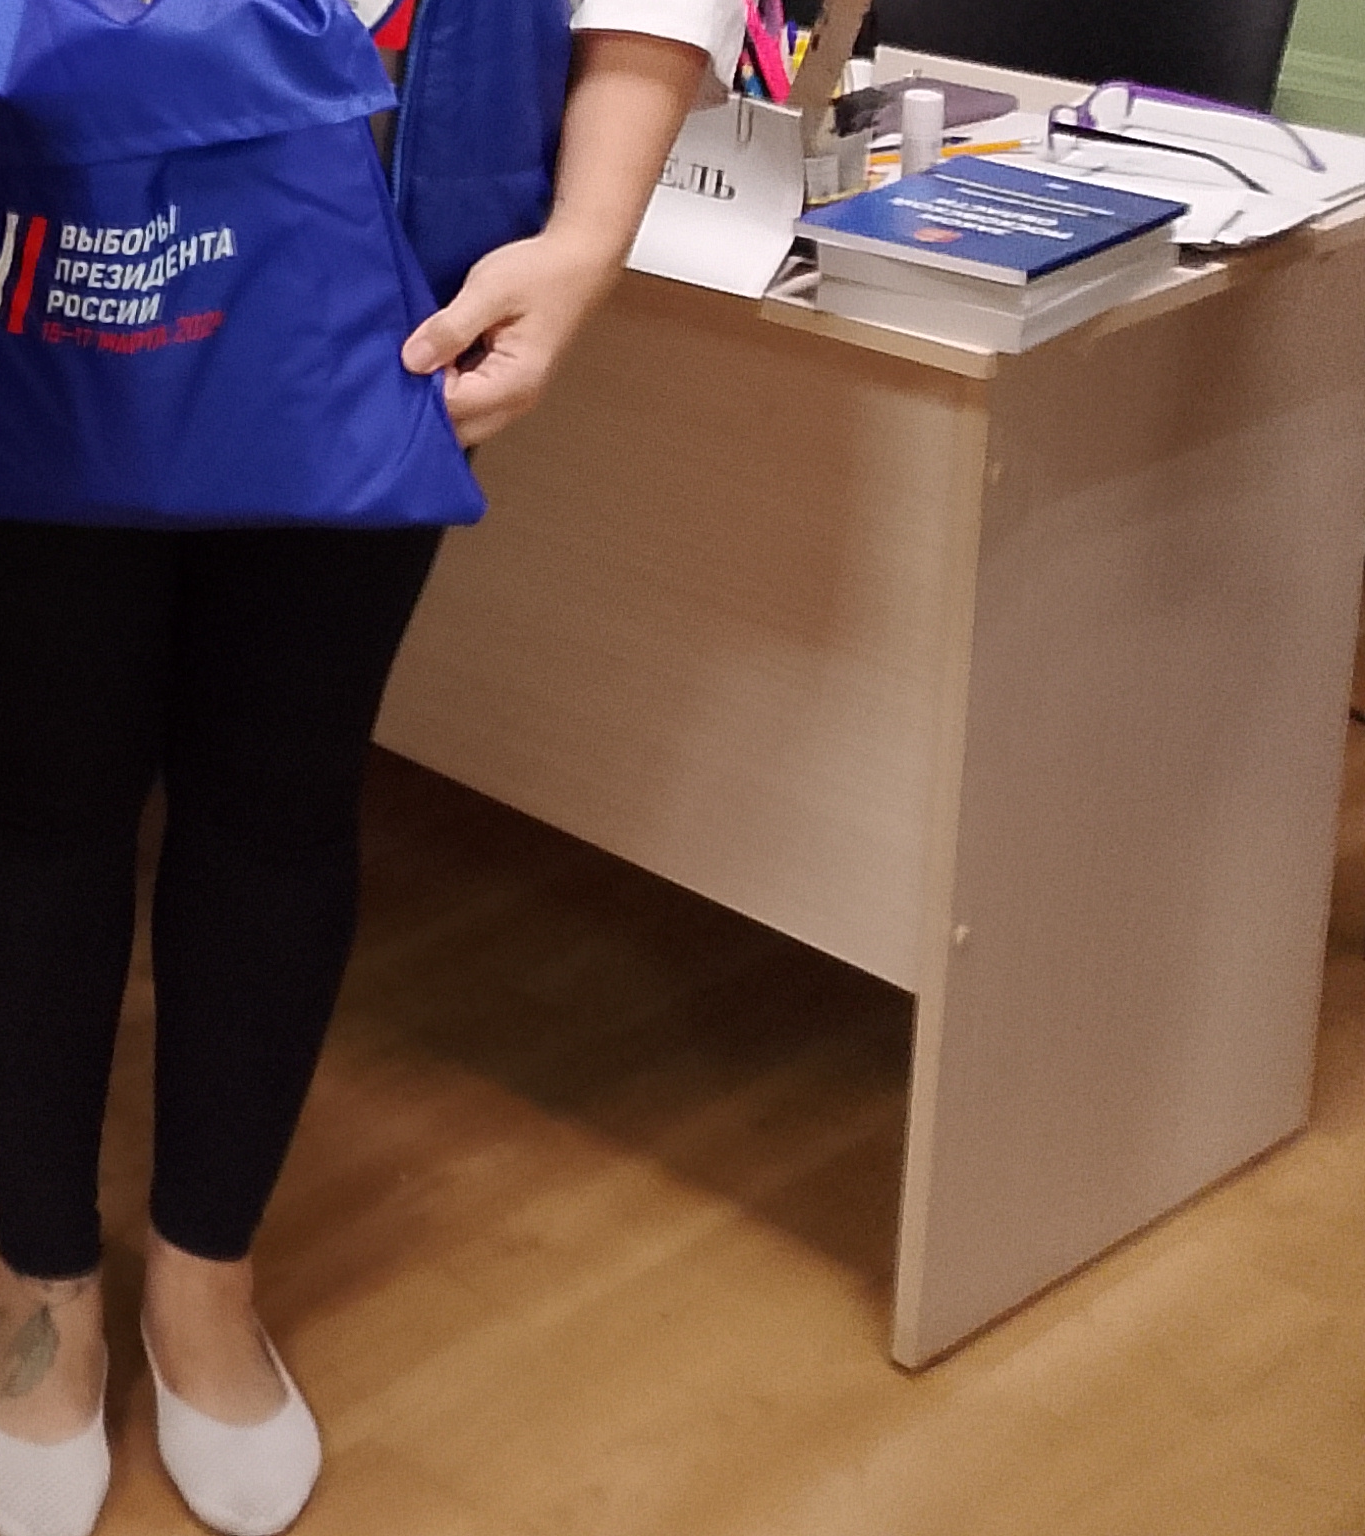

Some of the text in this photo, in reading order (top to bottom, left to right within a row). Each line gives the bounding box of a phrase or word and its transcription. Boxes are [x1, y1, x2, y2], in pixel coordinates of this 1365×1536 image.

[59, 204, 180, 256] ВЫБОРЫ
[54, 227, 237, 292] ПРЕЗИДЕНТА
[46, 289, 162, 326] РОССИИ
